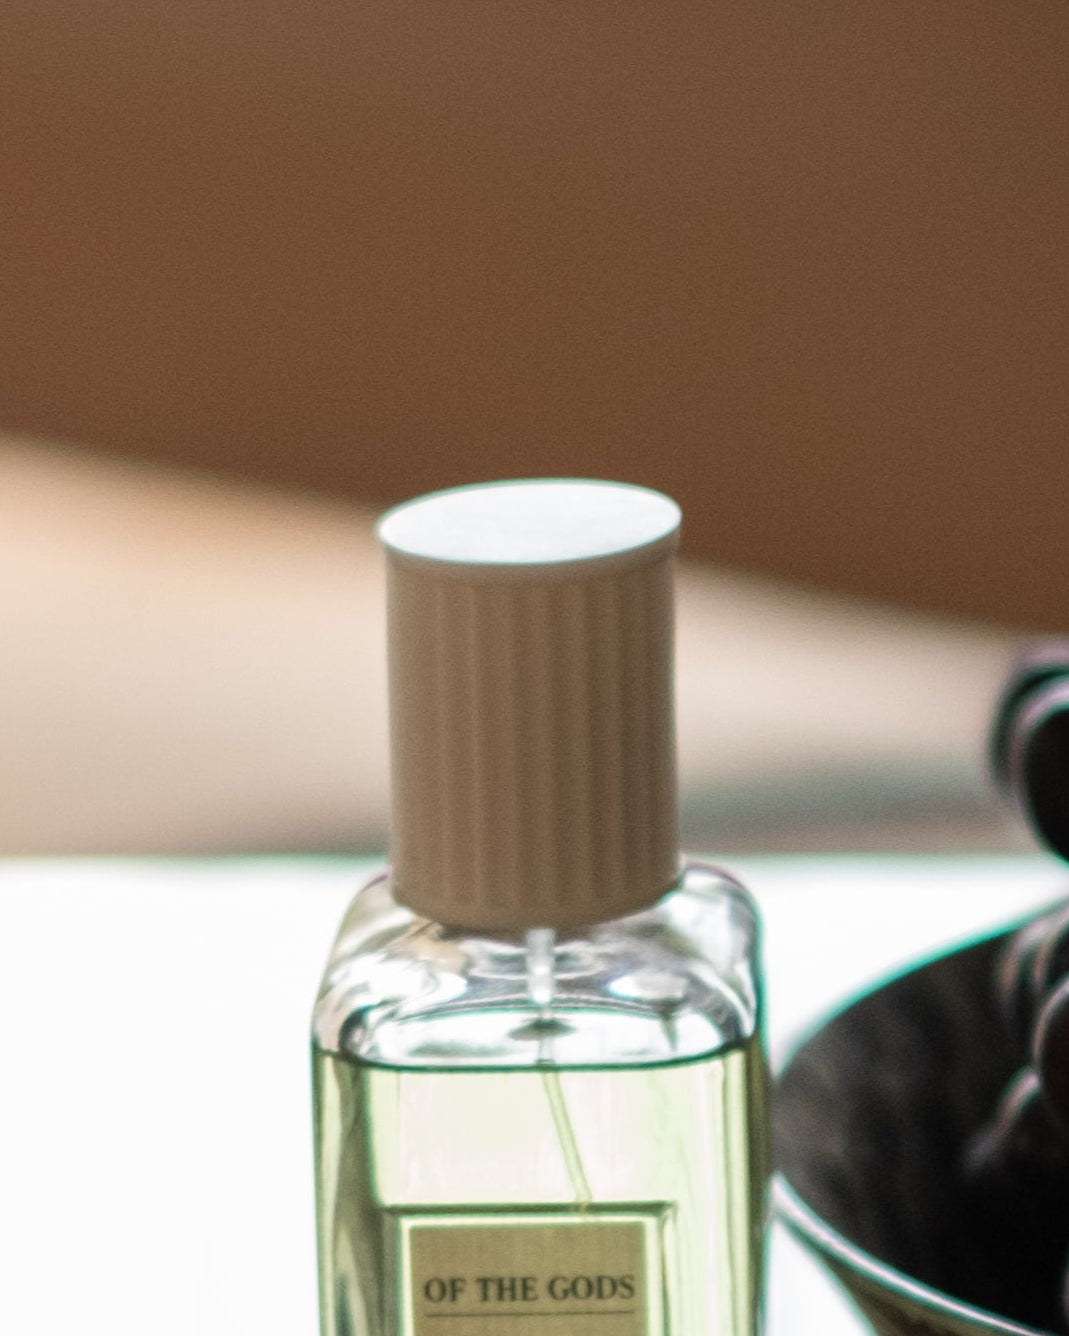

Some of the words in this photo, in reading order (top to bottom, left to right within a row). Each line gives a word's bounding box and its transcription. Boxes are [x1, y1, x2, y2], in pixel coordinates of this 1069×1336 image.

[422, 1277, 466, 1303] OF
[475, 1276, 538, 1302] THE
[545, 1274, 635, 1300] GODS
